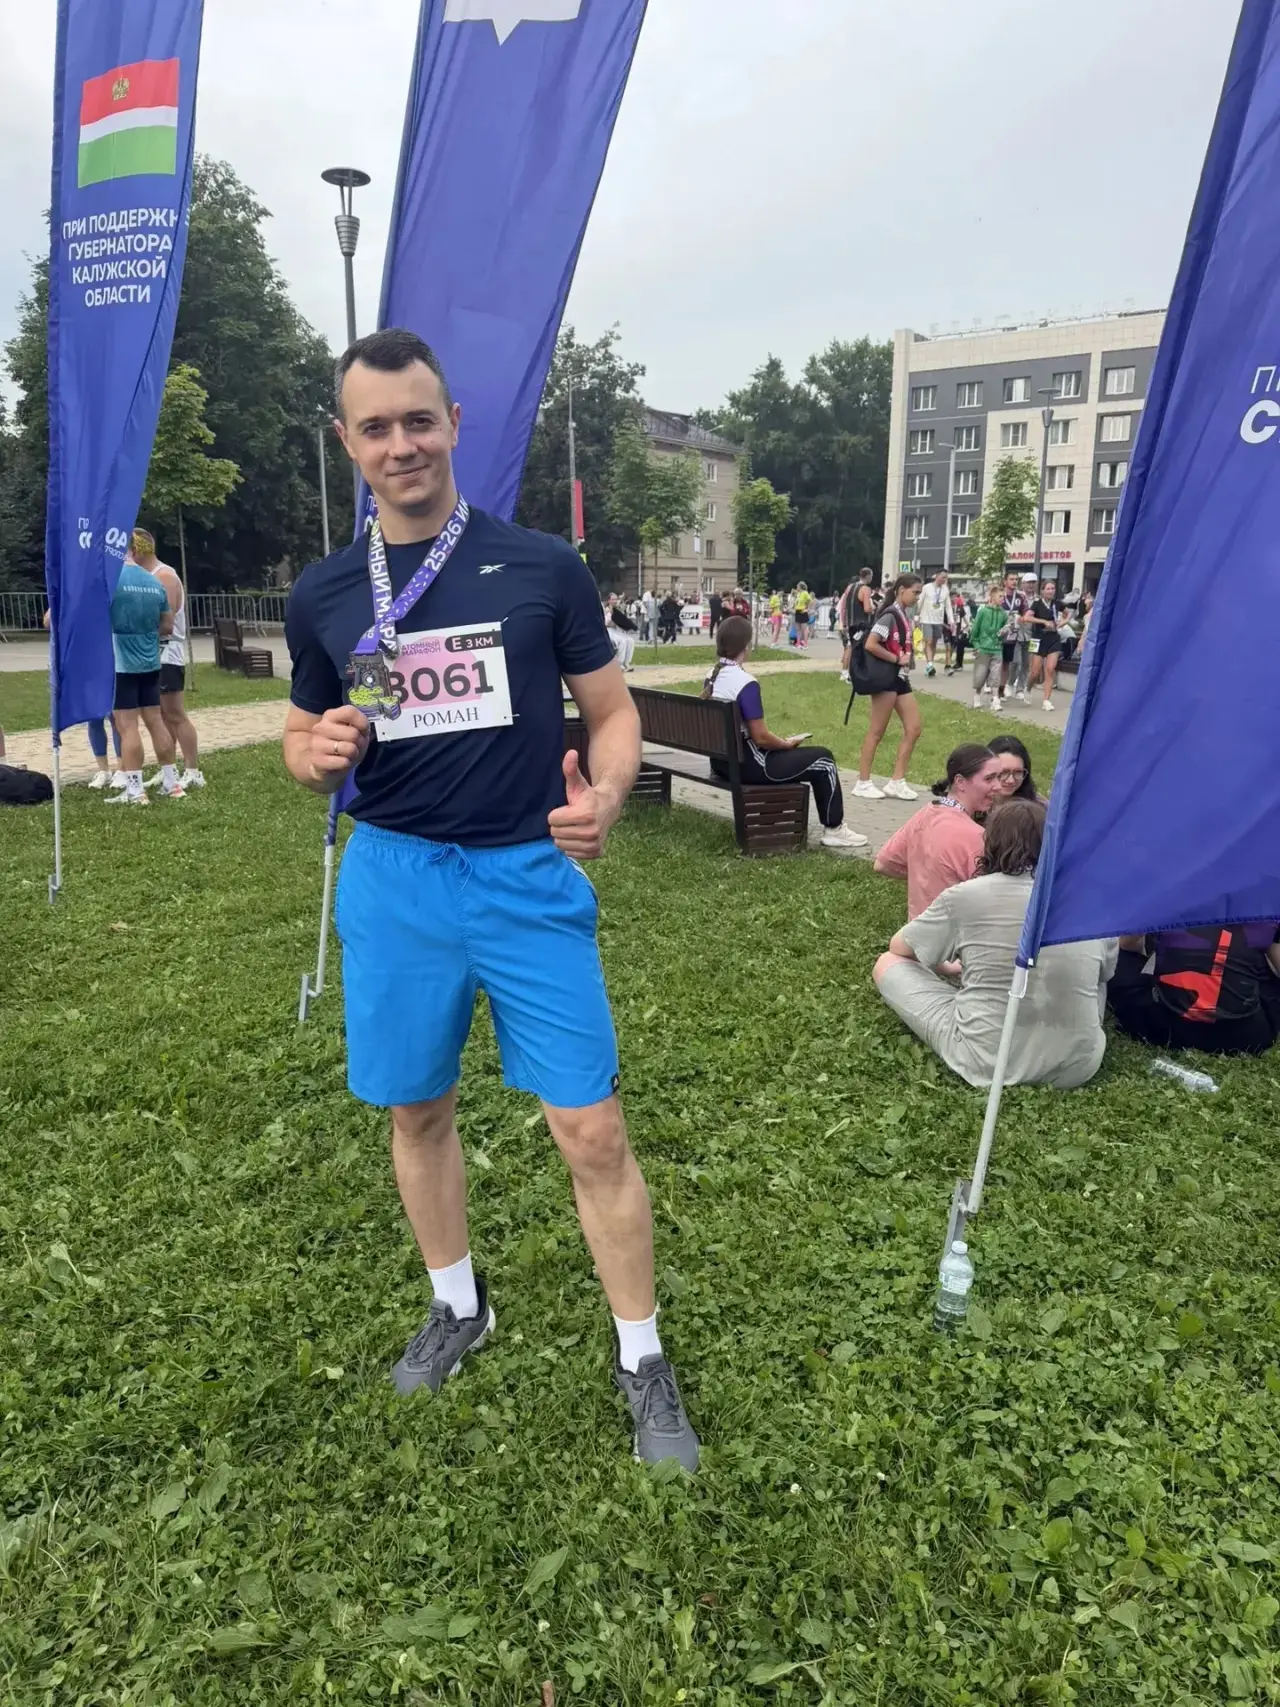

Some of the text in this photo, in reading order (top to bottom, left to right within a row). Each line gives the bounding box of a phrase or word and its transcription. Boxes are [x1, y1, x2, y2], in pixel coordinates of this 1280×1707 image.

[62, 217, 87, 240] ПРИ
[68, 233, 172, 261] ГУБЕРНАТОРА
[72, 255, 166, 285] КАЛУЖСКОЙ
[84, 284, 151, 308] ОБЛАСТИ
[401, 639, 440, 651] АТОМНЫЙ
[401, 647, 441, 657] МАРАФОН
[466, 638, 475, 648] 3
[476, 636, 494, 647] КМ
[412, 706, 480, 728] РОМАН
